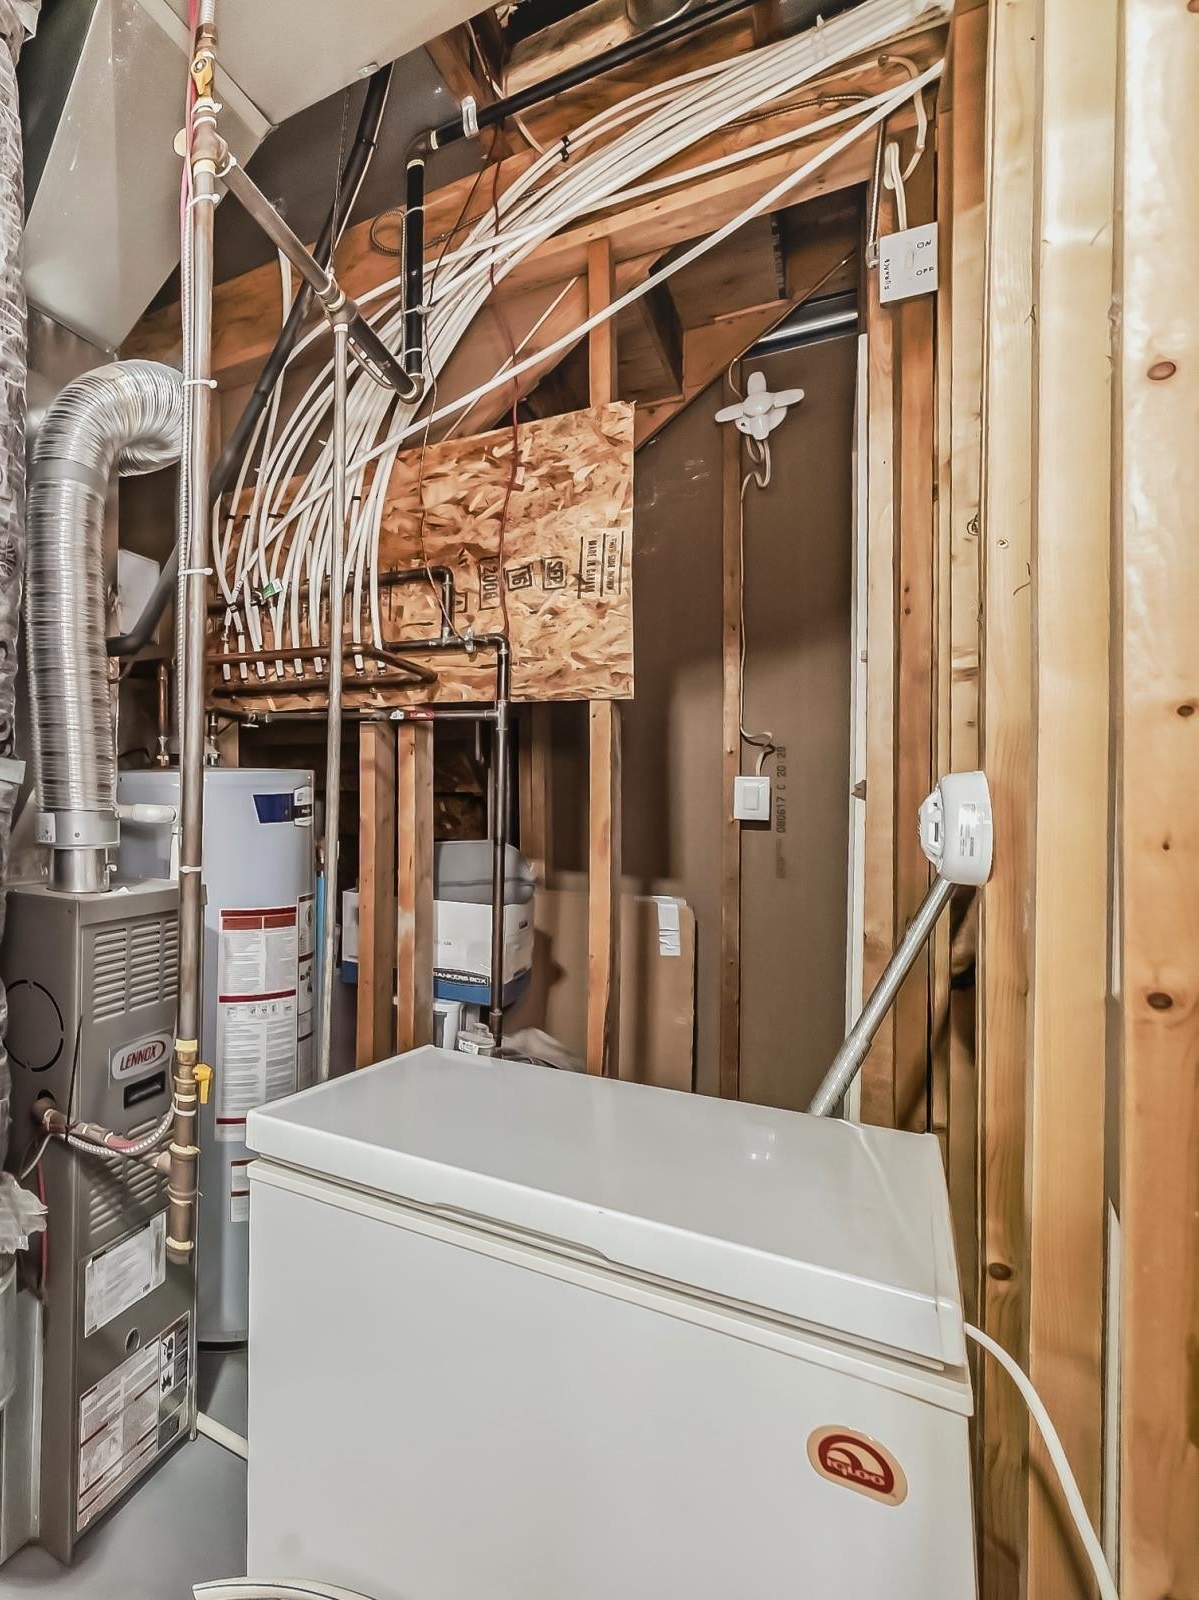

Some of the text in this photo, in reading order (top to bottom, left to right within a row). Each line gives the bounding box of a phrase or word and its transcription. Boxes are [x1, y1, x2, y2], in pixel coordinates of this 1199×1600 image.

[916, 239, 932, 249] ON
[915, 265, 935, 277] OFF
[119, 1044, 158, 1072] LENNOX
